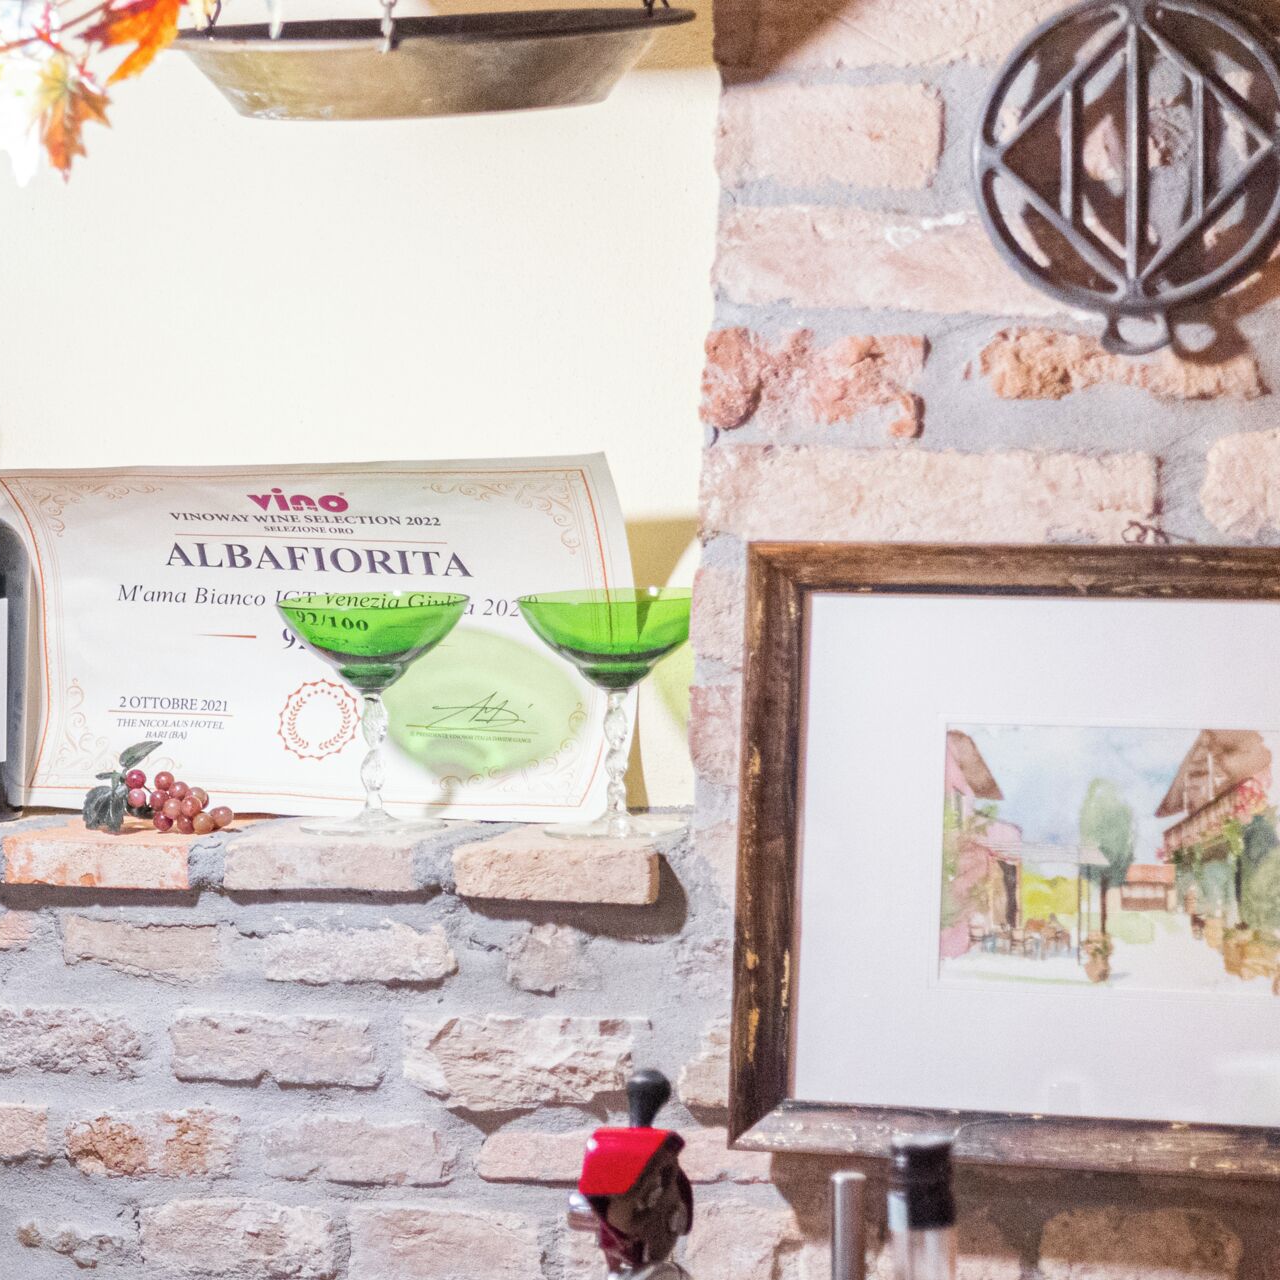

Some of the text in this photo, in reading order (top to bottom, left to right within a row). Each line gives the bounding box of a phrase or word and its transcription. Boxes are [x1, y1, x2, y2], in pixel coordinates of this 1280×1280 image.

[169, 511, 441, 527] VINOWAY WINE SELECTION 2022
[264, 525, 327, 535] SELEZIONE
[166, 541, 475, 578] ALBAFIORITA
[117, 583, 187, 604] M'ama
[195, 586, 266, 607] Bianco
[325, 592, 400, 609] Venezia
[295, 610, 369, 631] 92/100
[119, 696, 228, 712] 2 OTTOBRE 2021
[117, 718, 225, 730] THE NICOLAUS HOTEL
[145, 731, 188, 740] BARI (BA)
